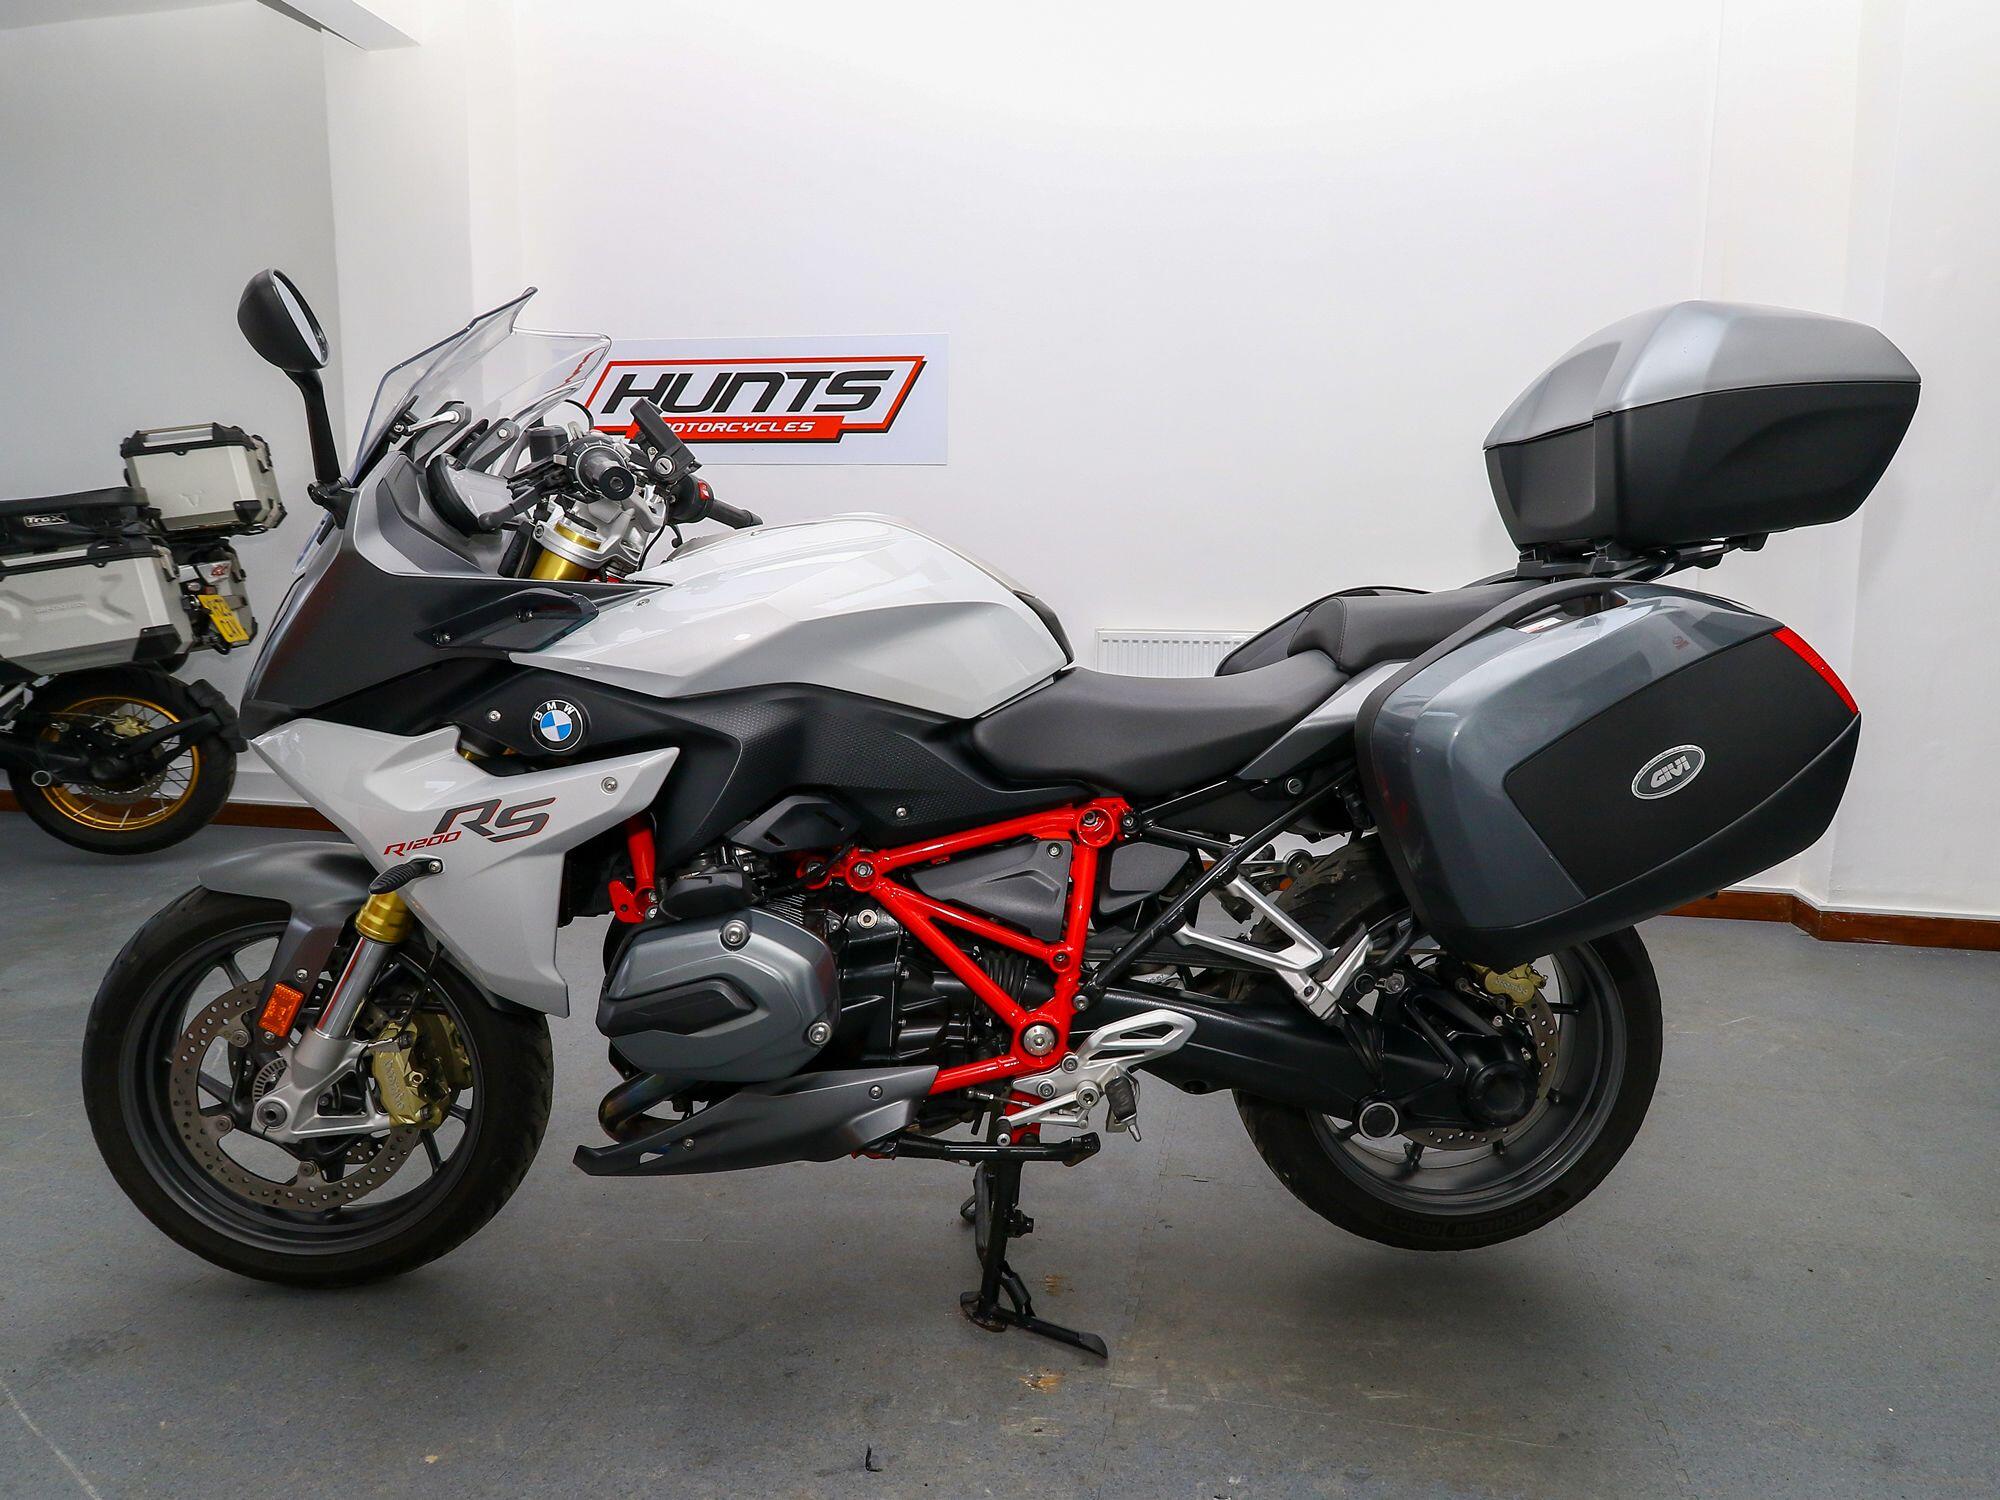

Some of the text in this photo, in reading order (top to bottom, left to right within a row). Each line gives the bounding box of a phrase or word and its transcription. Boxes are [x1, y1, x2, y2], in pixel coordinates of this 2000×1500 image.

[600, 369, 895, 414] HUNTS
[533, 701, 575, 722] BMW
[1650, 755, 1691, 788] GIVI
[383, 797, 557, 856] R1200 RS
